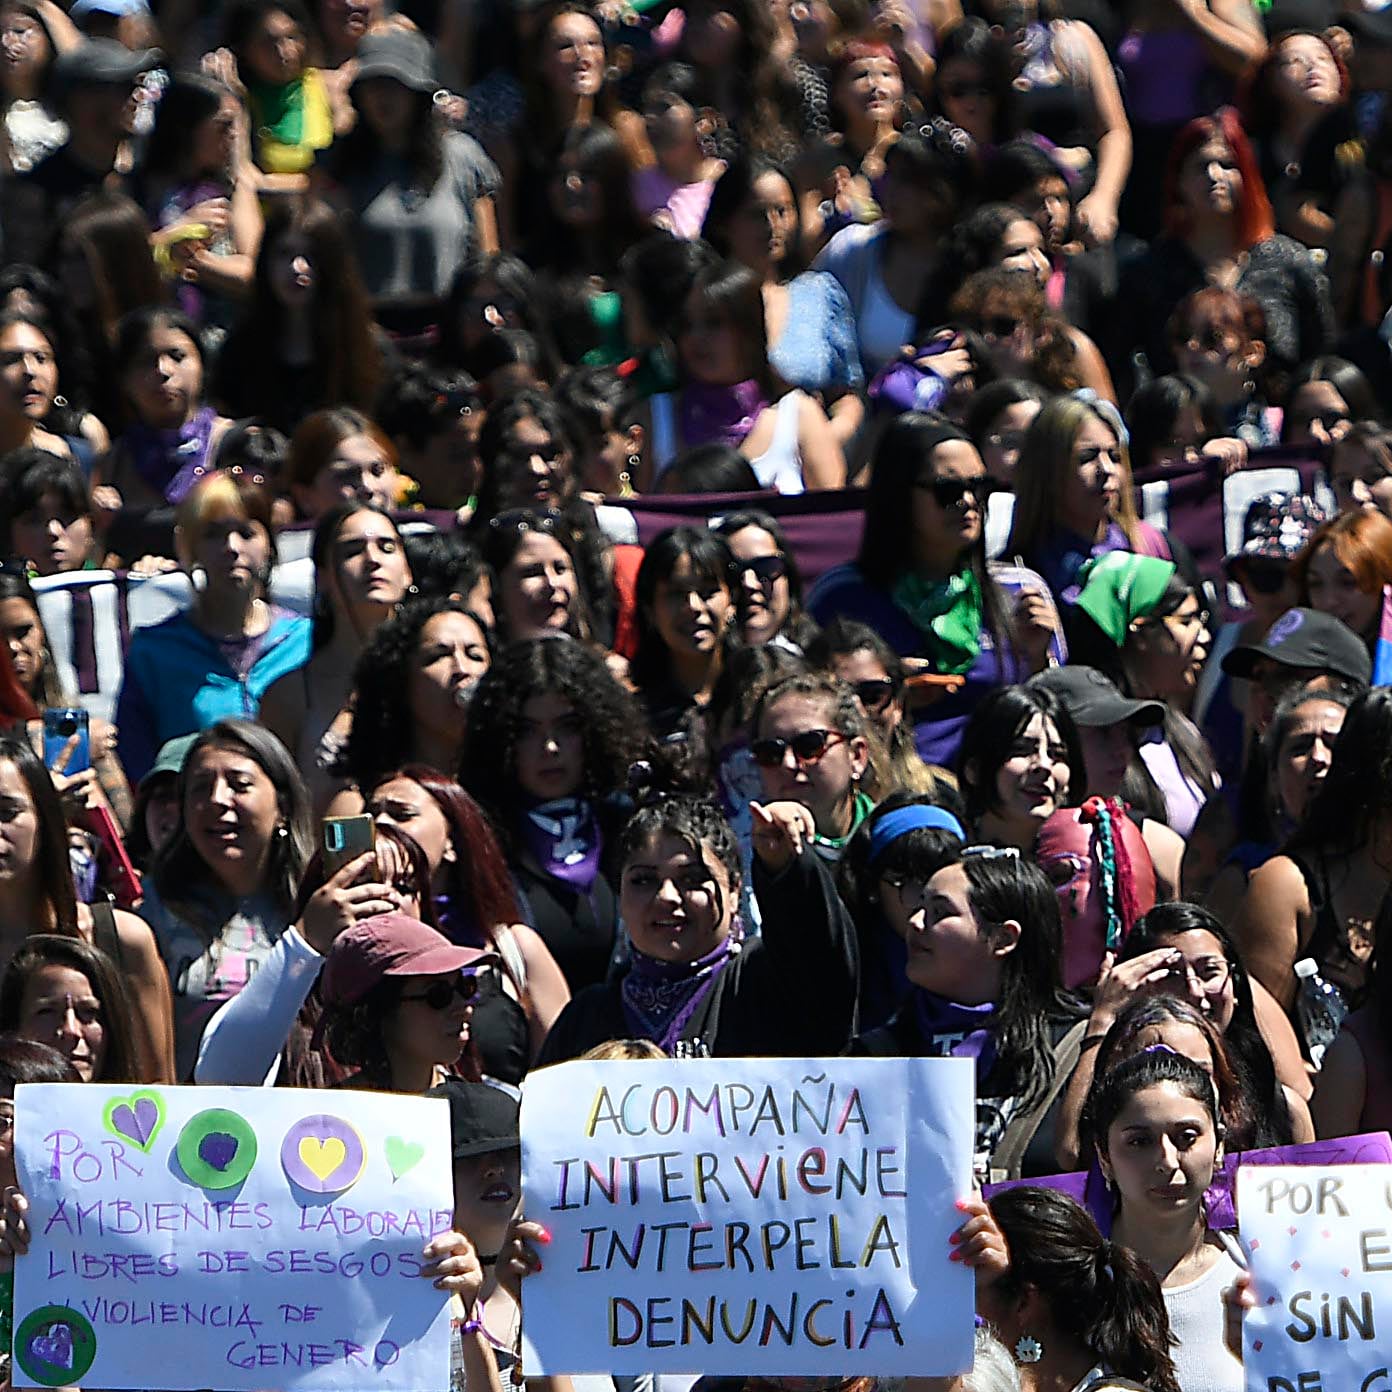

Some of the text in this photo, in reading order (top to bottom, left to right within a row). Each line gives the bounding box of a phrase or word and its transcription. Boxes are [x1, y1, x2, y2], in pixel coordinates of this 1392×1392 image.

[585, 1072, 870, 1138] ACOMPAÑA
[43, 1129, 144, 1183] POR
[1256, 1176, 1350, 1218] POR
[43, 1198, 274, 1237] AMBIENTES
[577, 1213, 903, 1273] INTERPELA
[47, 1250, 425, 1284] LIBRES DE SESGOS
[279, 1303, 323, 1323] DE
[227, 1339, 401, 1373] GENERO
